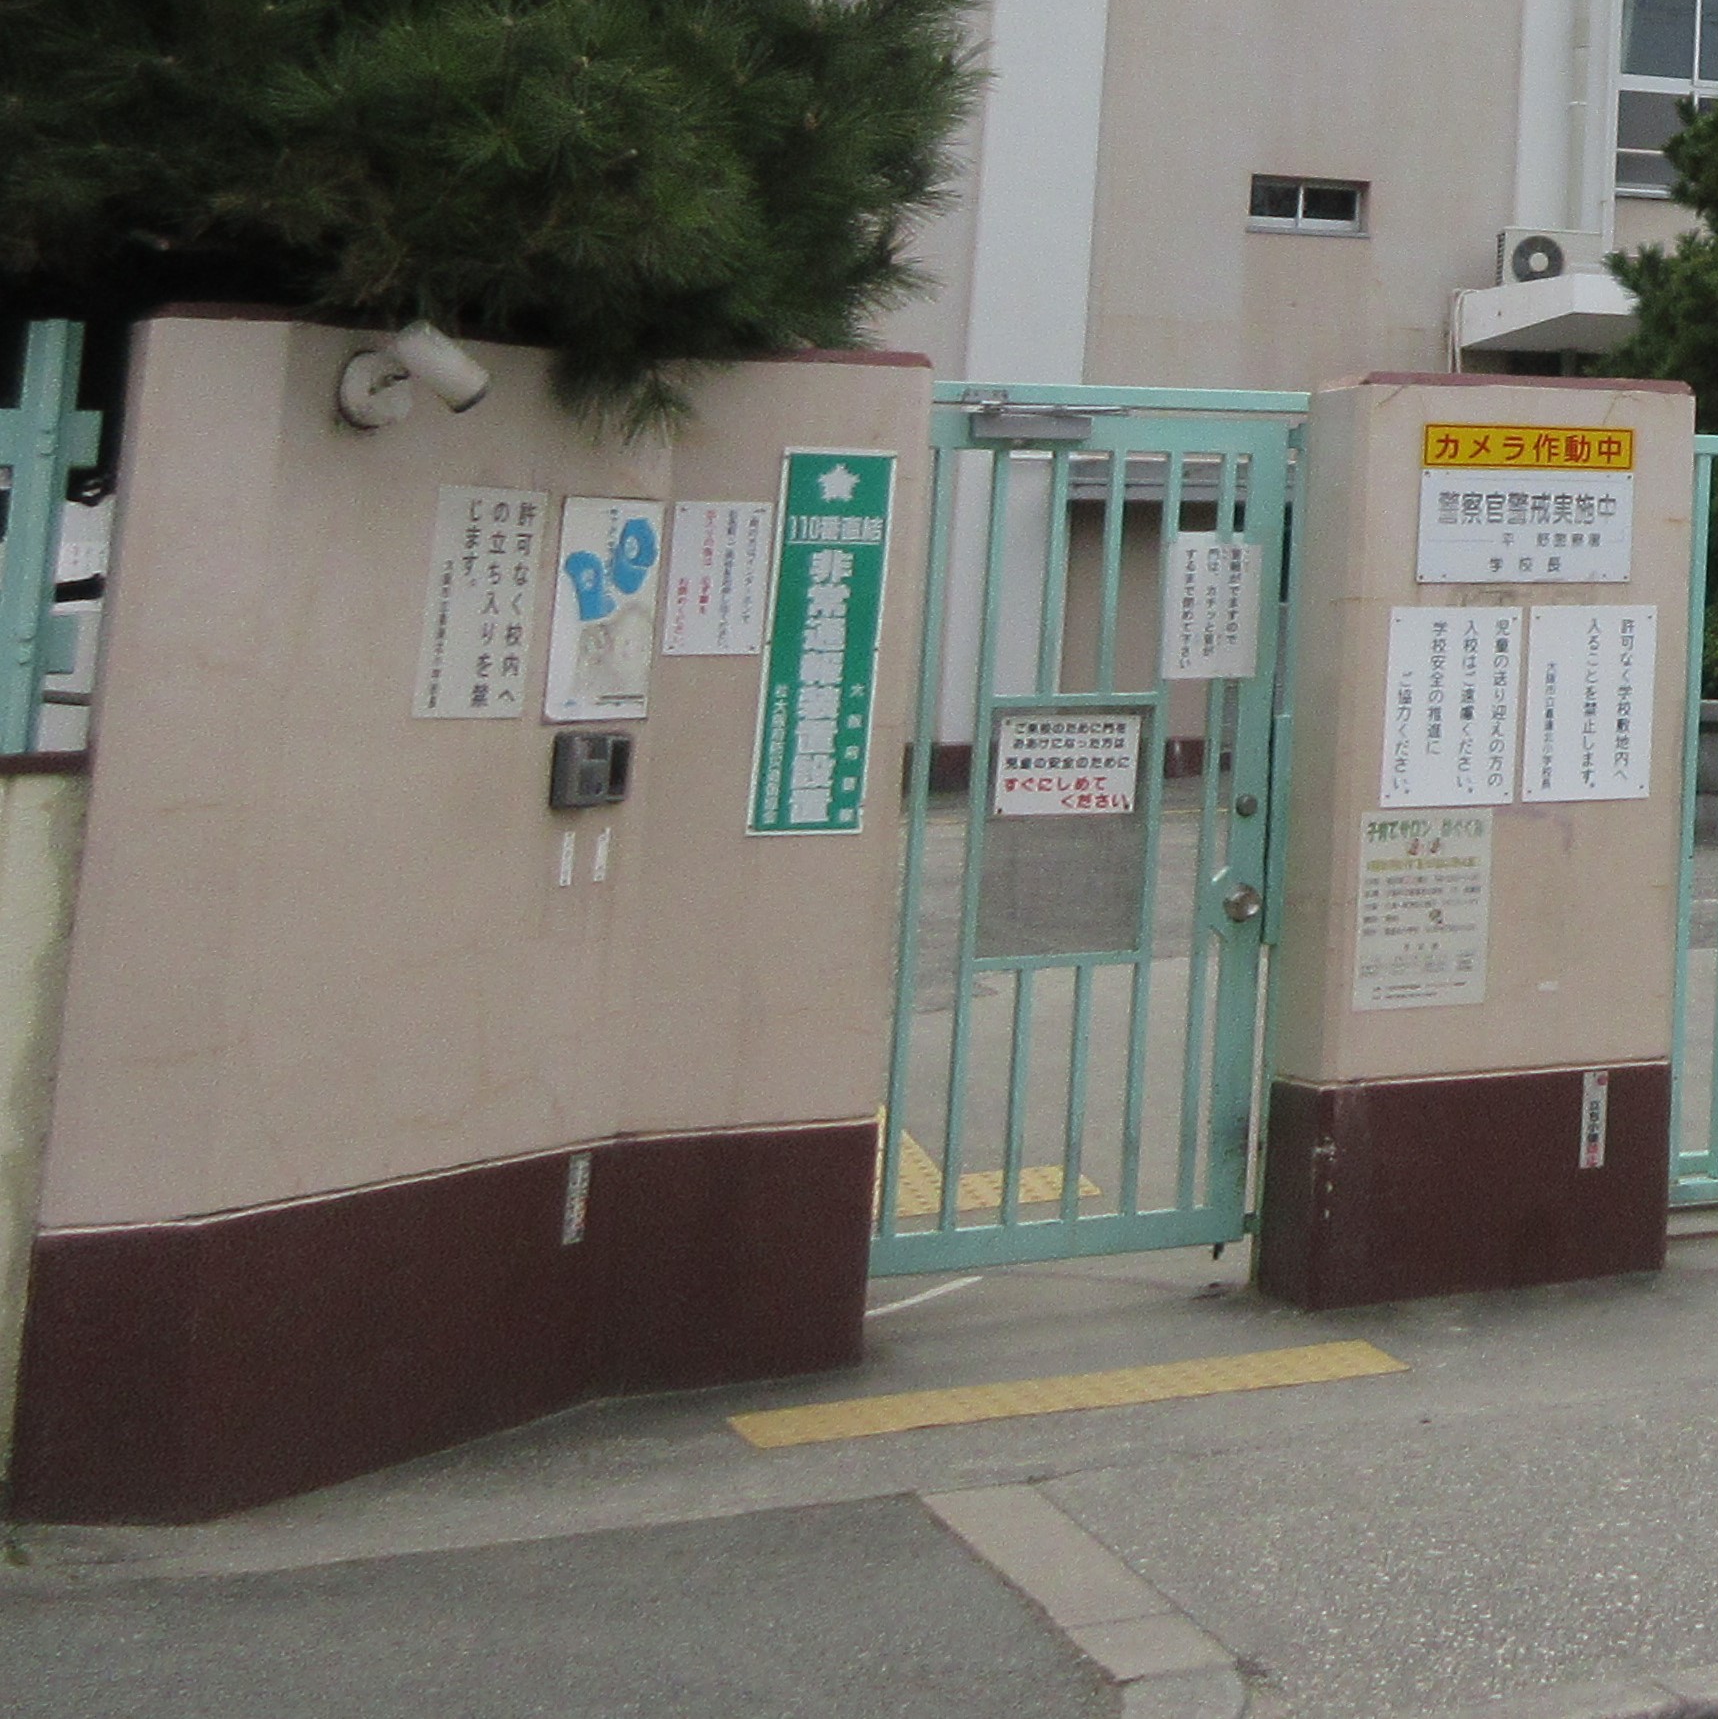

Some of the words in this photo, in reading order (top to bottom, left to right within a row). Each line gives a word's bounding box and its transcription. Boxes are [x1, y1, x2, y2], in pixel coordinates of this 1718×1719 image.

[1435, 433, 1622, 463] カメラ作動中
[1438, 490, 1617, 525] 警察官警戒実施中
[498, 501, 537, 703] 許可なく校内へ
[788, 515, 884, 541] 110番直結
[471, 501, 510, 708] の立ち入りを禁
[1426, 621, 1448, 755] 学校安全の推進に
[1487, 619, 1511, 787] 児童の送り迎えの方の
[1581, 618, 1601, 788] 入ることを禁止します。
[1614, 618, 1636, 780] 許可なく学校敷地内へ
[1004, 776, 1107, 792] すぐにしめて
